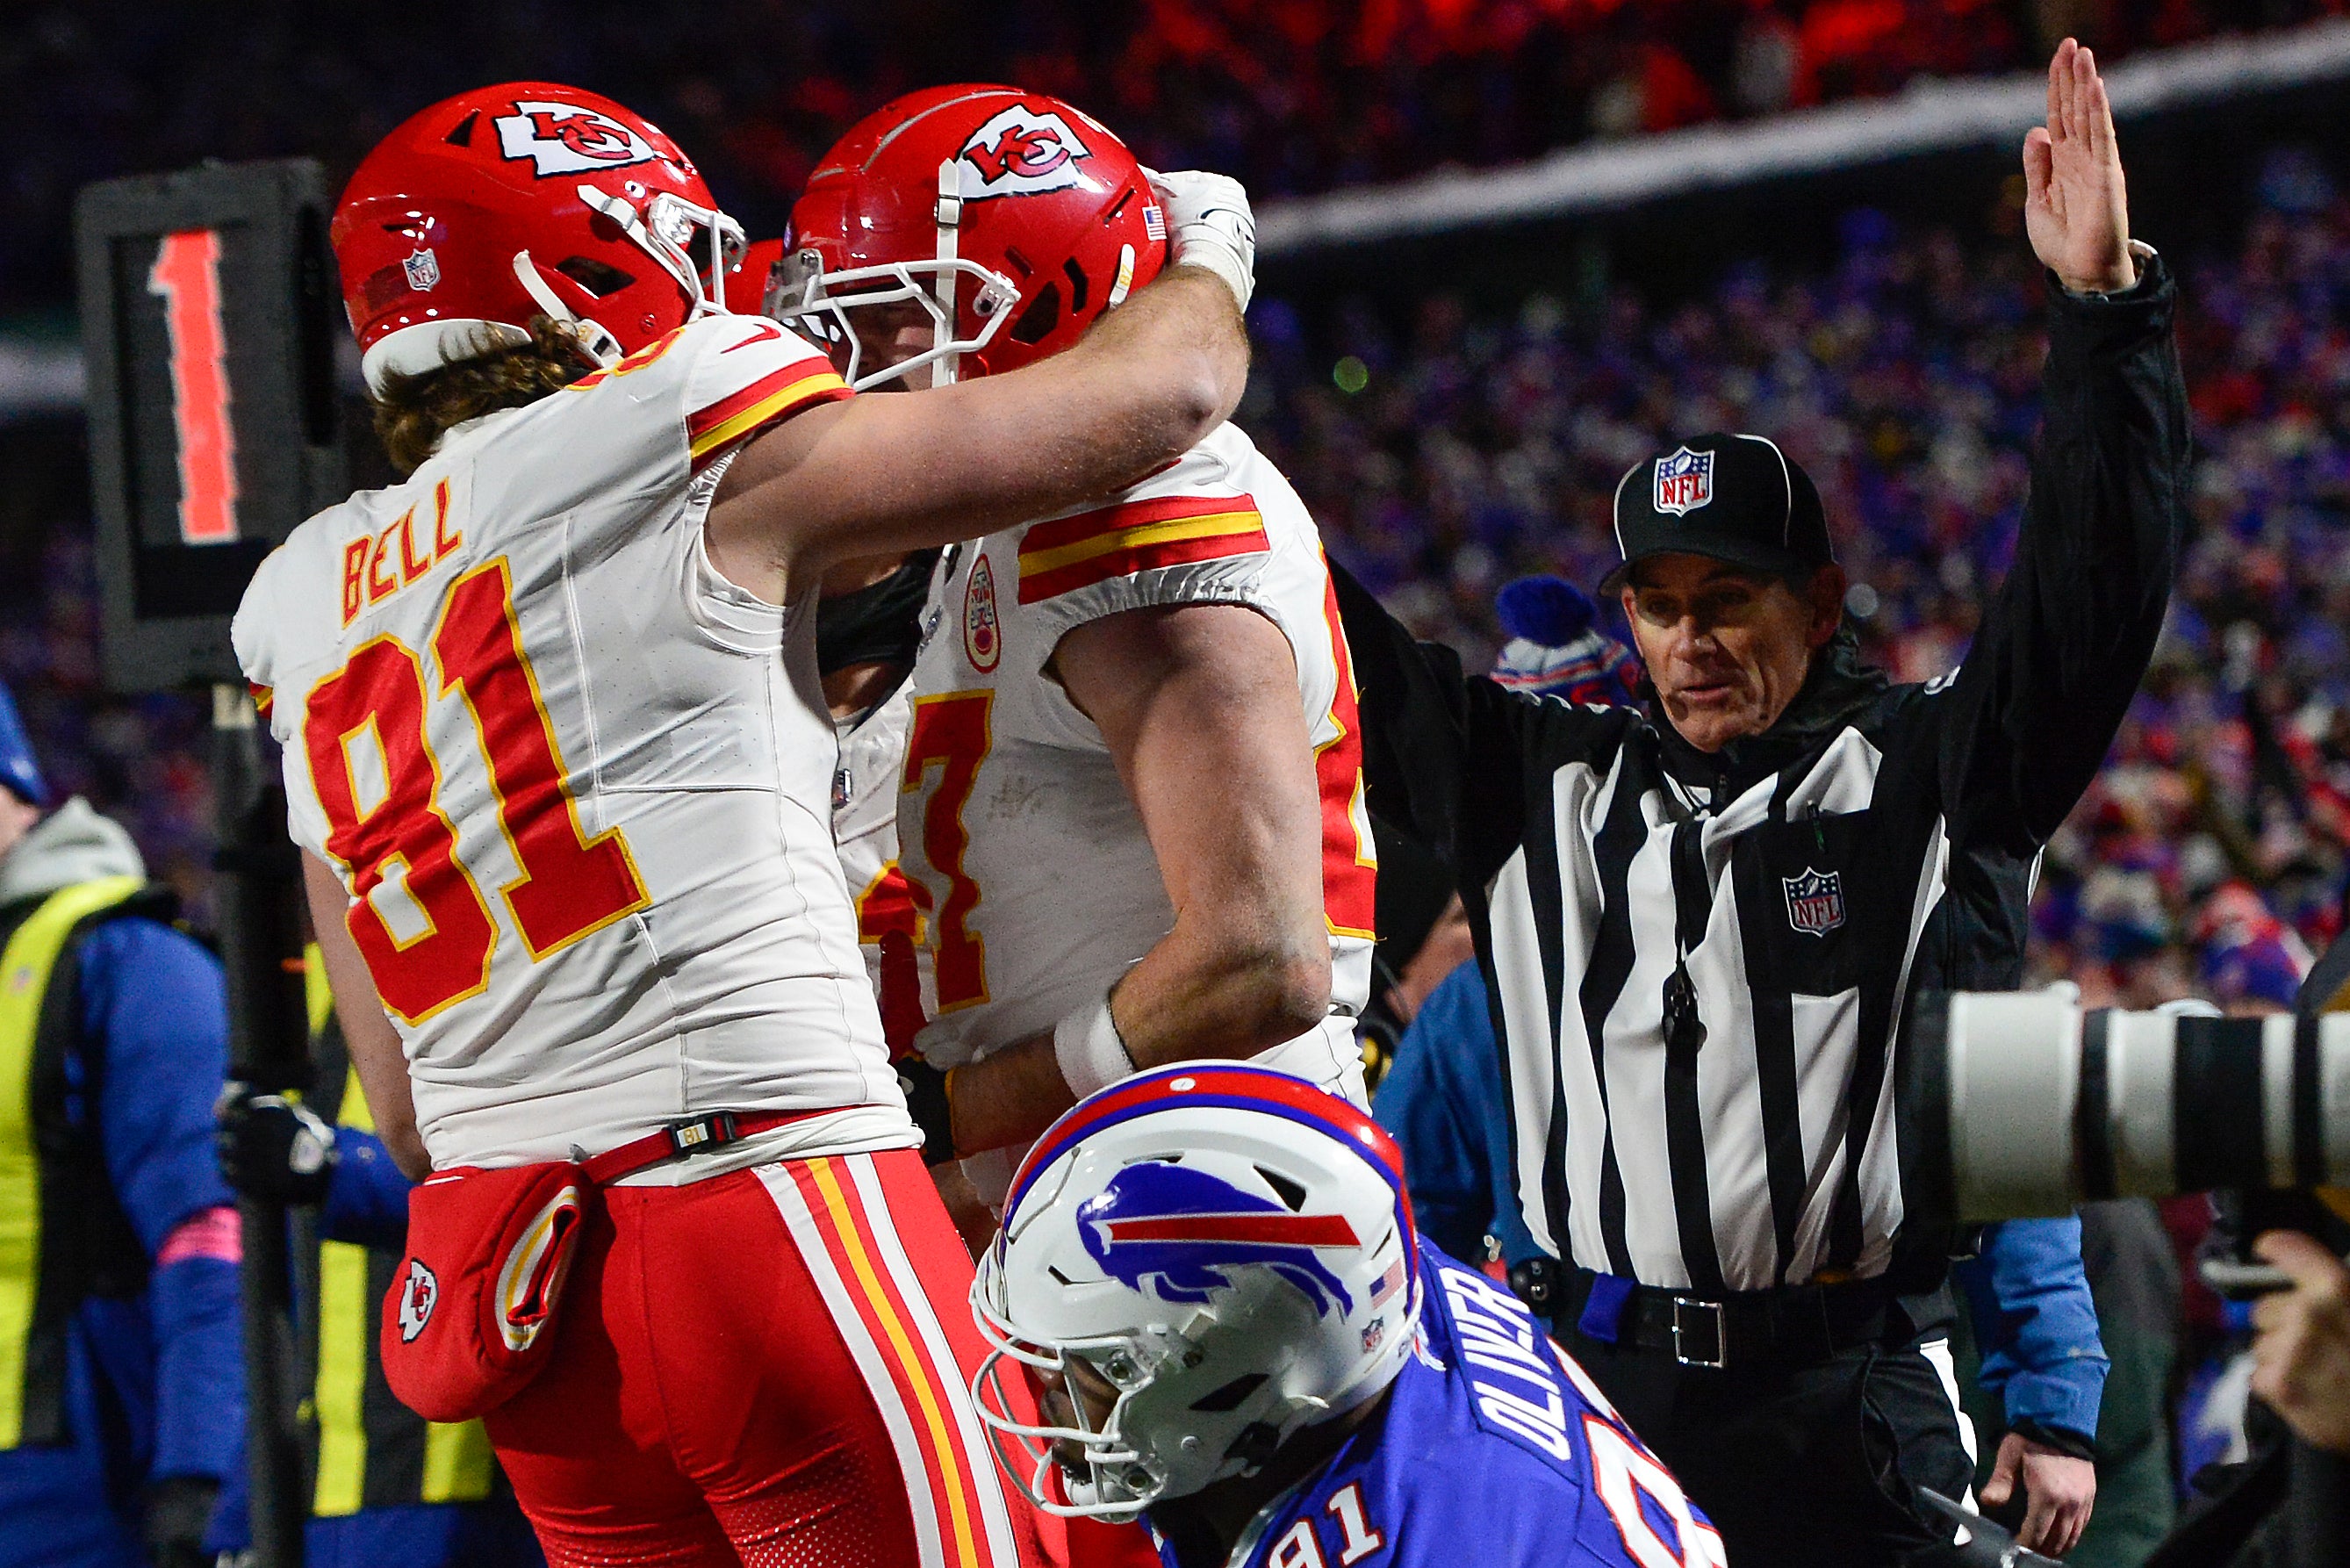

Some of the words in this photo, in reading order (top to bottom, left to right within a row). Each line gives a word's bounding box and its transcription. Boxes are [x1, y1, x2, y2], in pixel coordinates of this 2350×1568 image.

[963, 124, 1071, 186] KC
[147, 229, 241, 546] 1
[341, 476, 463, 630] BELL
[1662, 474, 1707, 506] NFL
[304, 554, 652, 1028] 81
[1794, 895, 1841, 927] NFL
[1439, 1267, 1572, 1462] OLIVER
